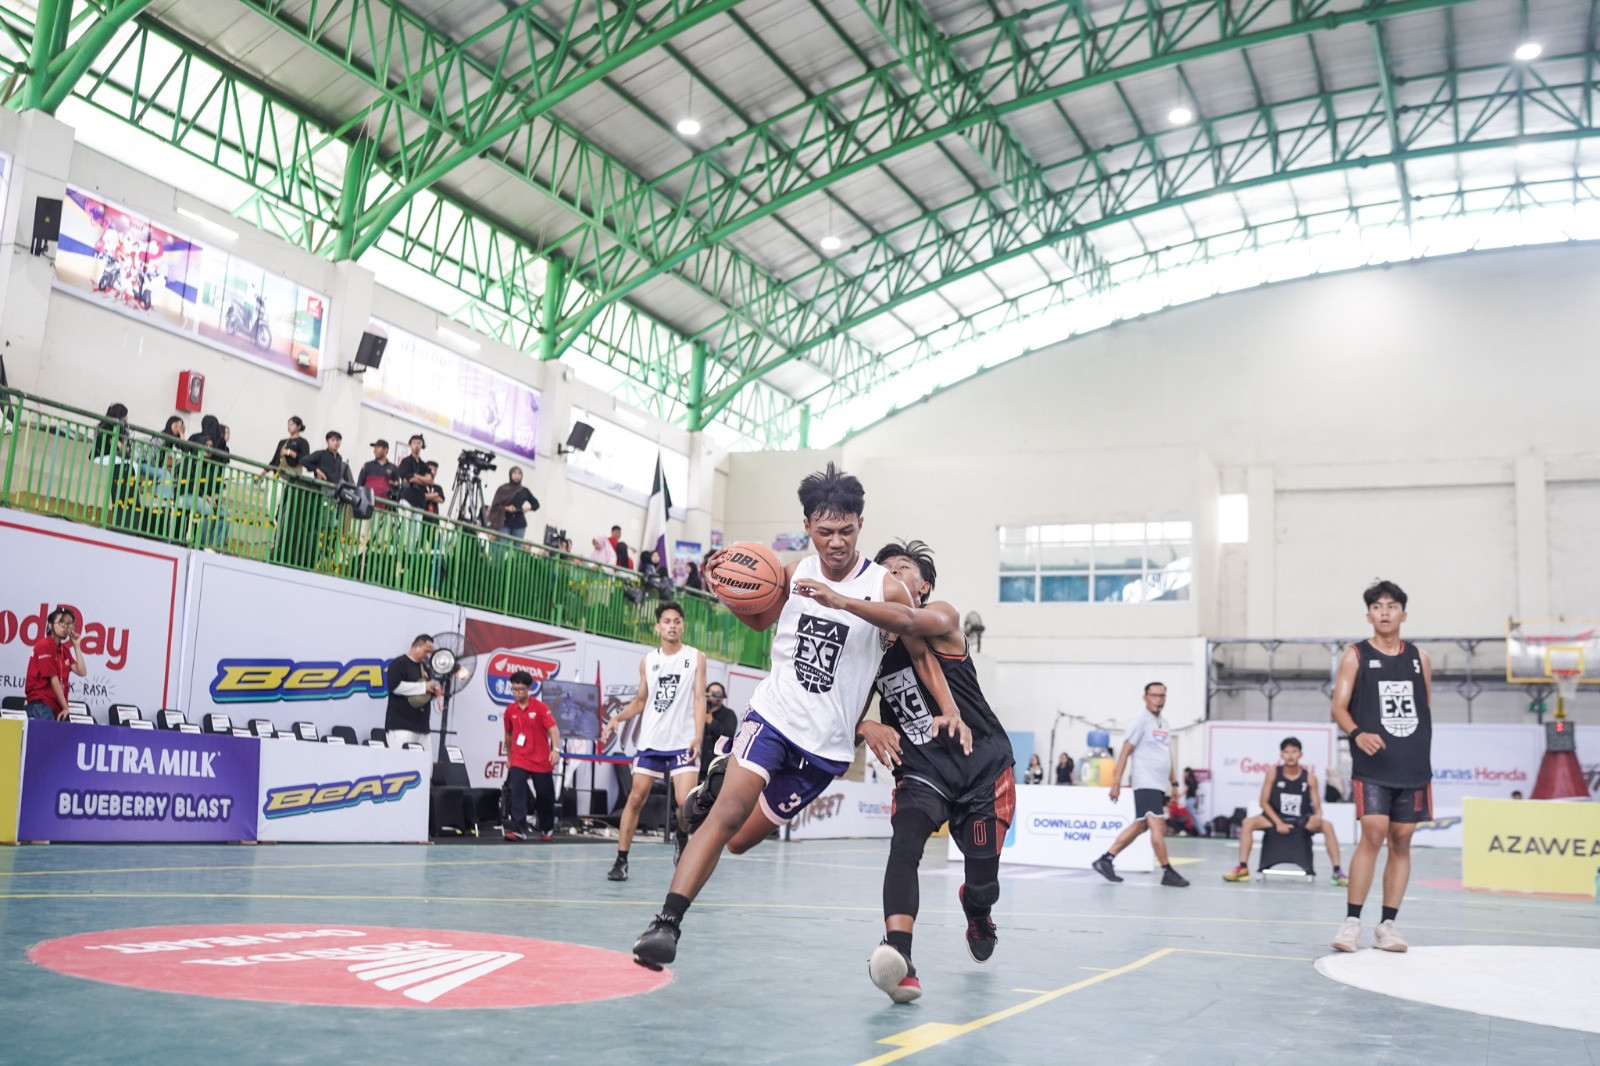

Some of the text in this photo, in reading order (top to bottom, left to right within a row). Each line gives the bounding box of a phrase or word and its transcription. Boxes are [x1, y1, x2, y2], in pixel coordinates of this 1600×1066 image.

[730, 552, 759, 571] DBL
[1413, 659, 1421, 673] 5
[83, 684, 108, 697] RASA
[77, 742, 217, 778] ULTRA MILK
[484, 760, 507, 779] GET
[1474, 767, 1527, 782] Honda
[58, 792, 232, 820] BLUEBERRY BLAST
[1033, 818, 1123, 831] DOWNLOAD APP
[1064, 831, 1091, 841] NOW
